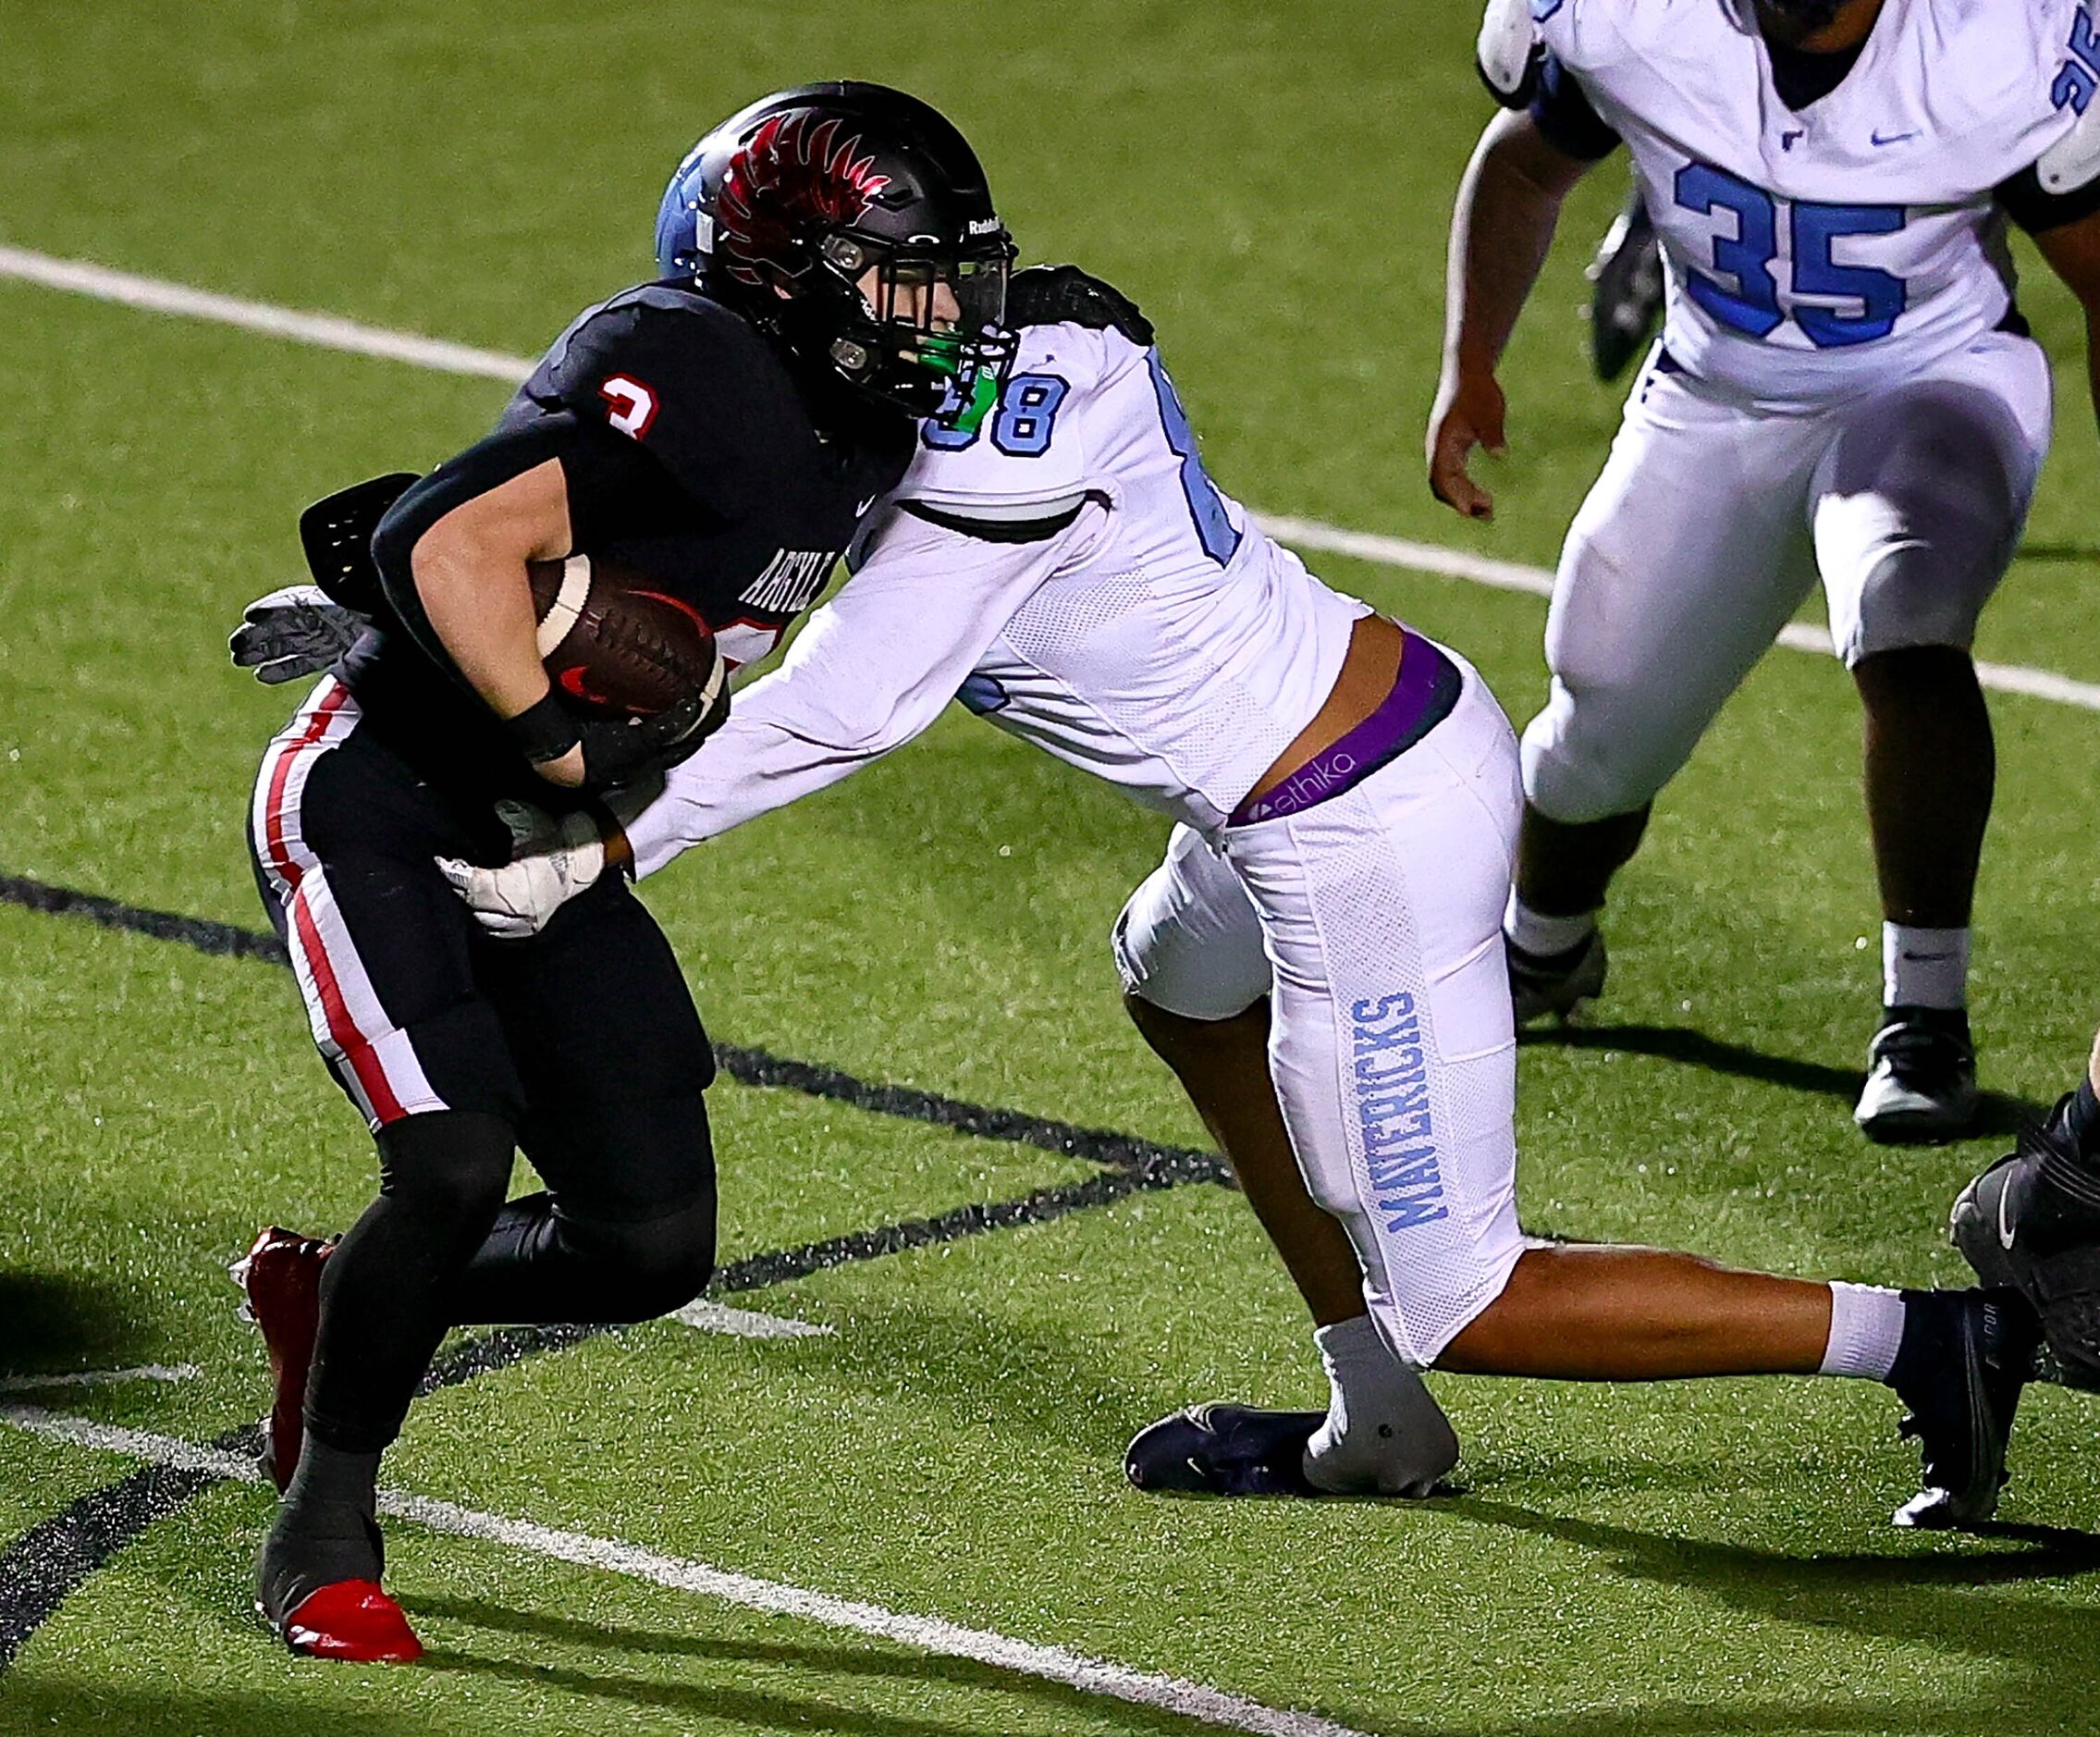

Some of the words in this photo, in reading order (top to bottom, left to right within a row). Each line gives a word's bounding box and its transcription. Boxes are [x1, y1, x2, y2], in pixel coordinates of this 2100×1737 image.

[1674, 160, 1907, 348] 35
[738, 548, 835, 612] ARGYLE
[1274, 753, 1357, 813] ethika
[1351, 991, 1449, 1234] MAVERICKS
